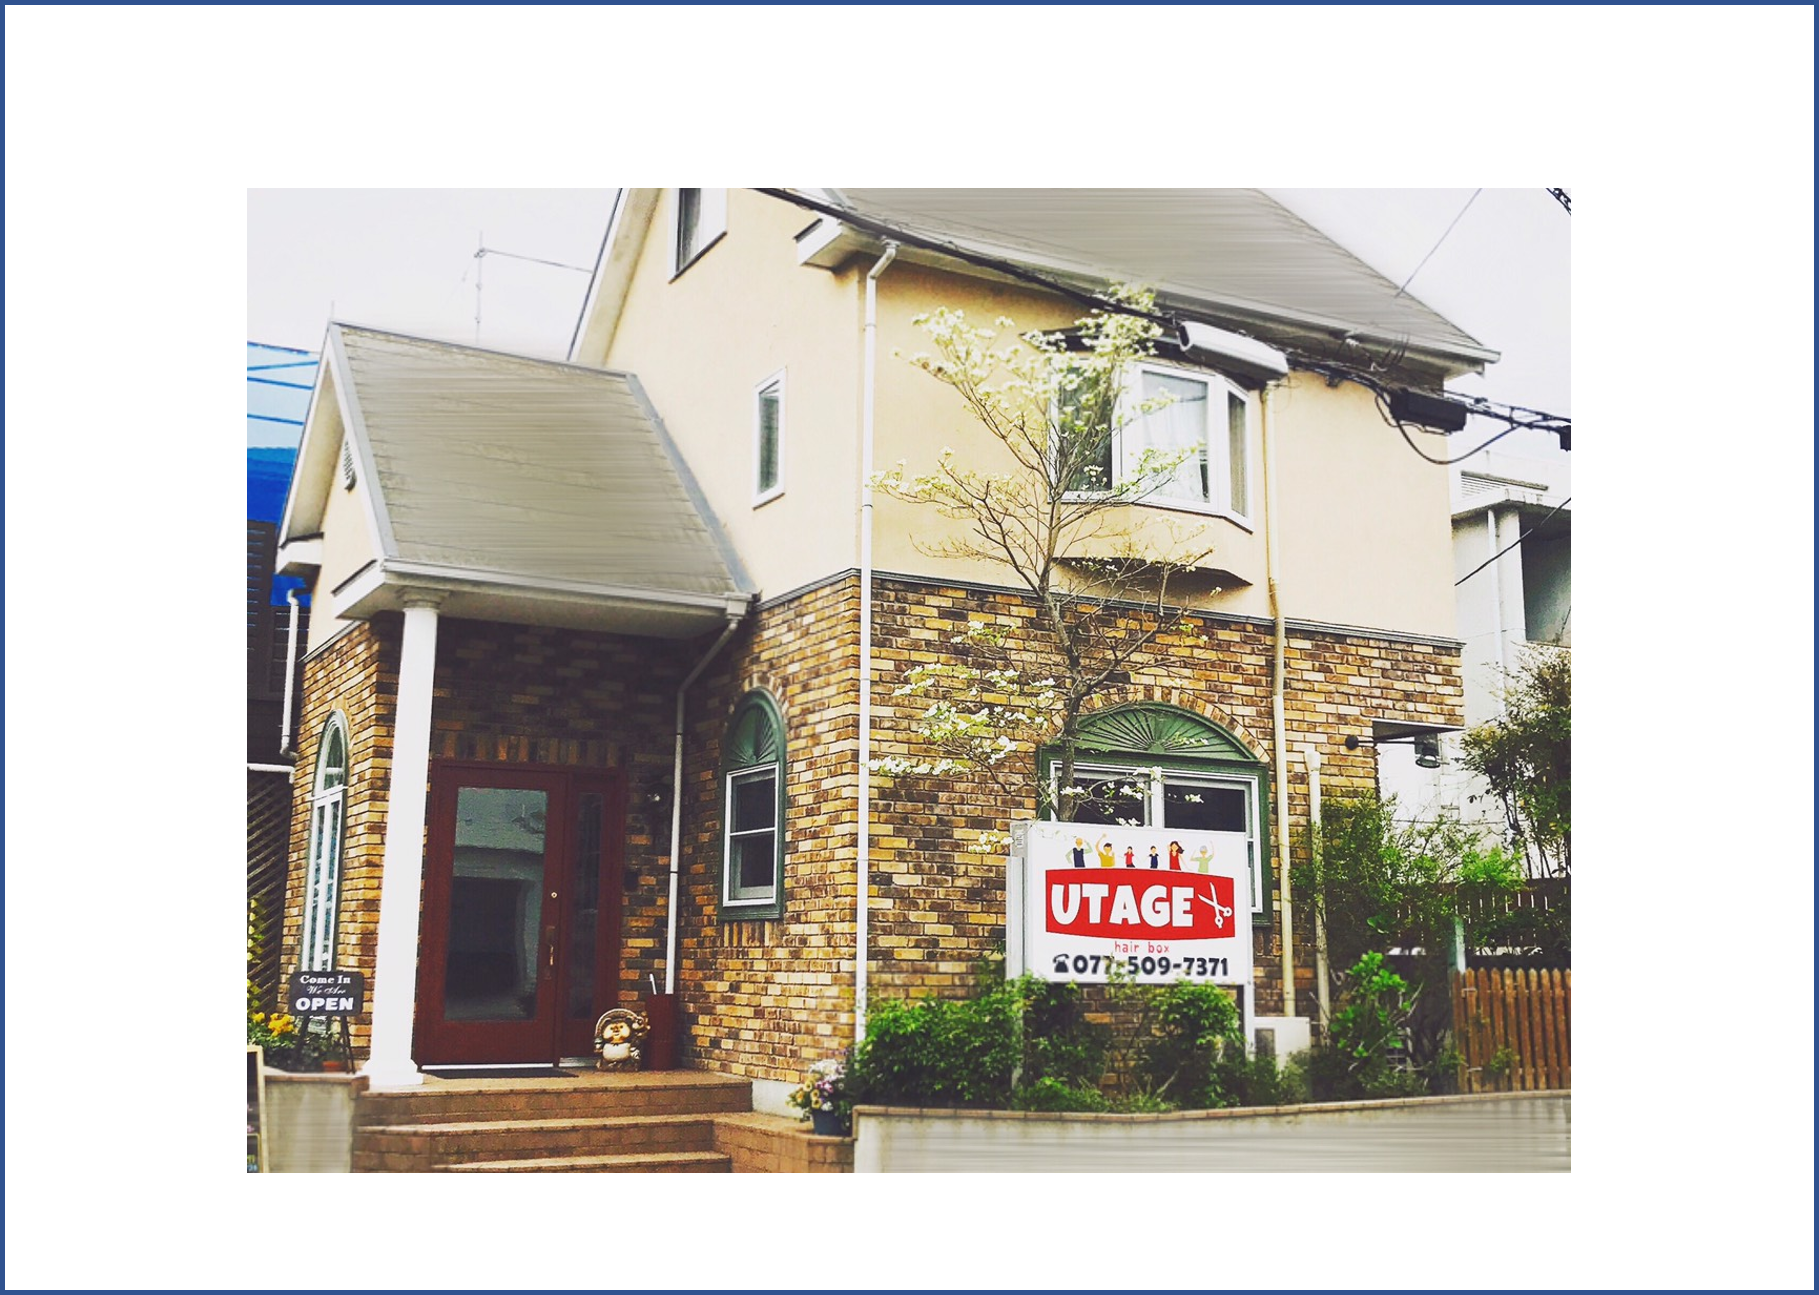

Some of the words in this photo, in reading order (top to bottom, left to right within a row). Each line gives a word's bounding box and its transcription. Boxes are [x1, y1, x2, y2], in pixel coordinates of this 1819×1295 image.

[1051, 883, 1195, 928] UTAGE
[1114, 940, 1140, 953] hair
[1147, 942, 1170, 954] box
[300, 975, 335, 984] Come
[337, 975, 352, 984] In
[306, 985, 323, 995] We
[323, 985, 347, 995] Are
[295, 997, 354, 1011] OPEN
